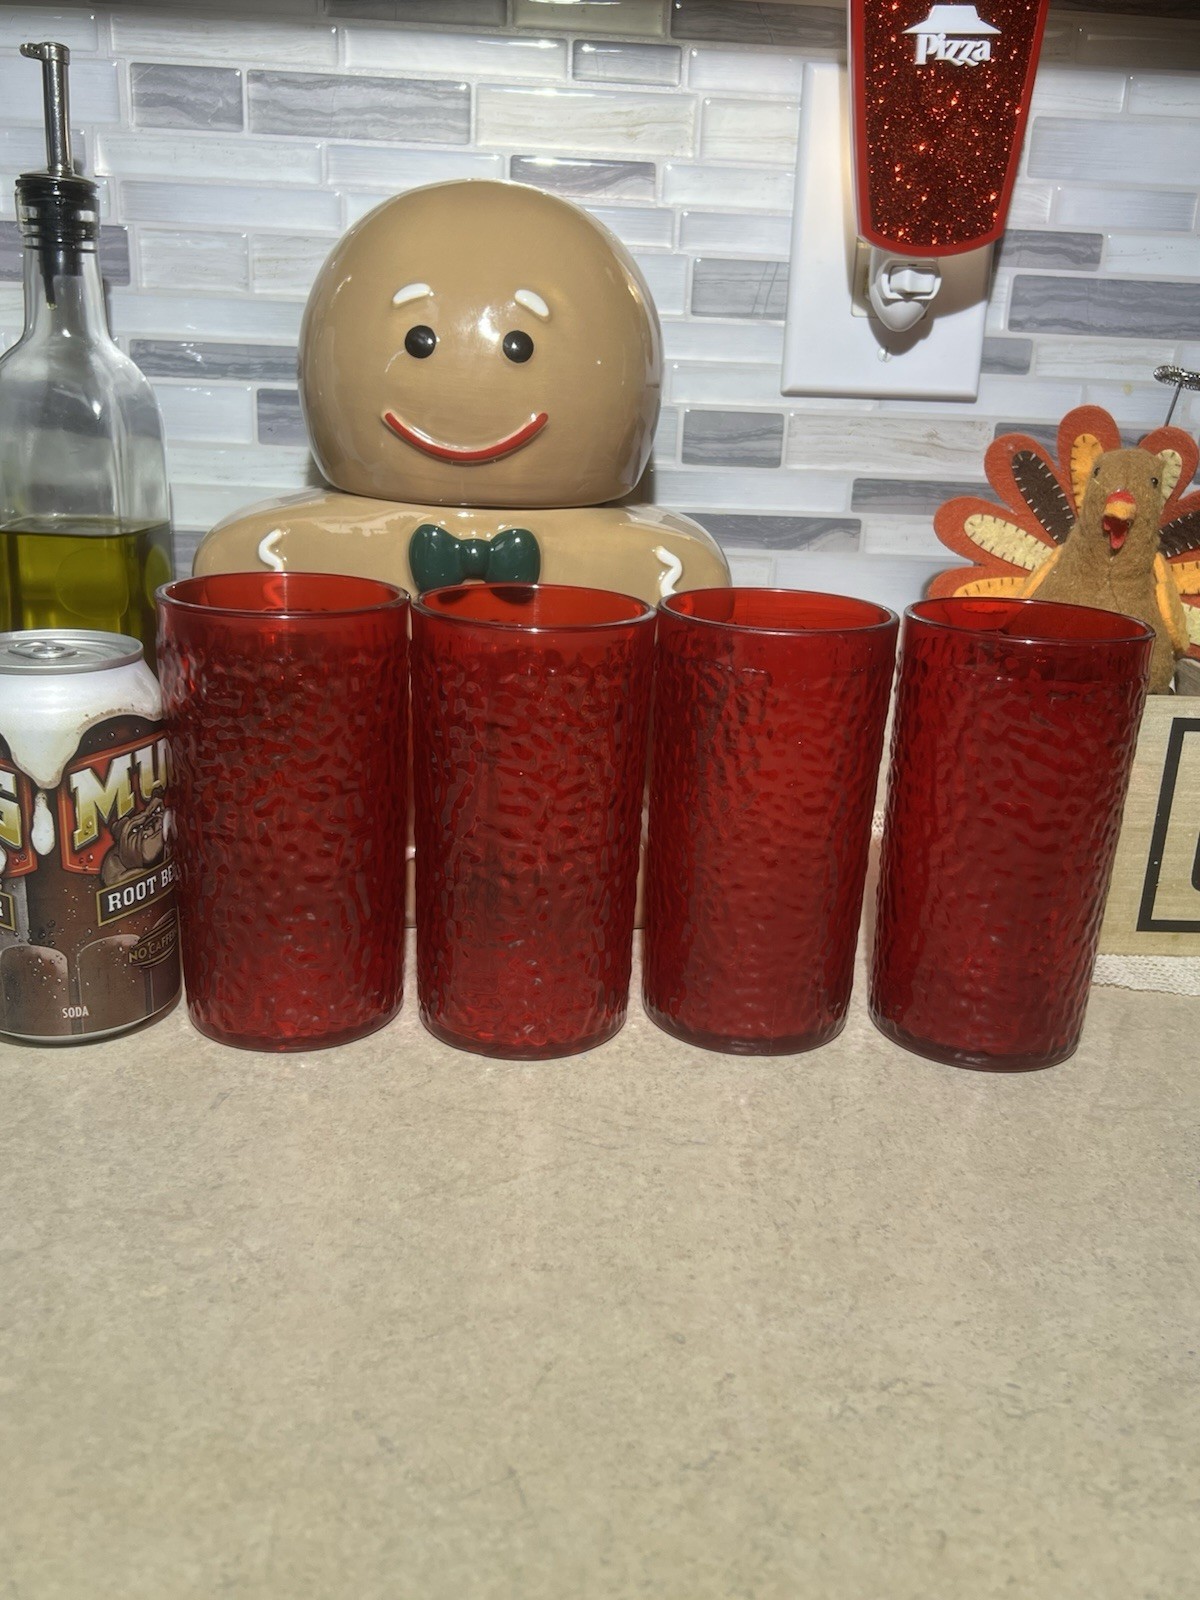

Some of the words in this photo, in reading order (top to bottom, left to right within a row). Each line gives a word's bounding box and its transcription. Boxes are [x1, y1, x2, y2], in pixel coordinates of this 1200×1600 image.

[914, 33, 992, 67] Pizza
[70, 737, 170, 851] MU
[107, 875, 157, 912] ROOT
[160, 861, 178, 888] BE
[128, 948, 148, 963] NO
[148, 929, 177, 956] CAFFE
[62, 1005, 90, 1019] SODA
